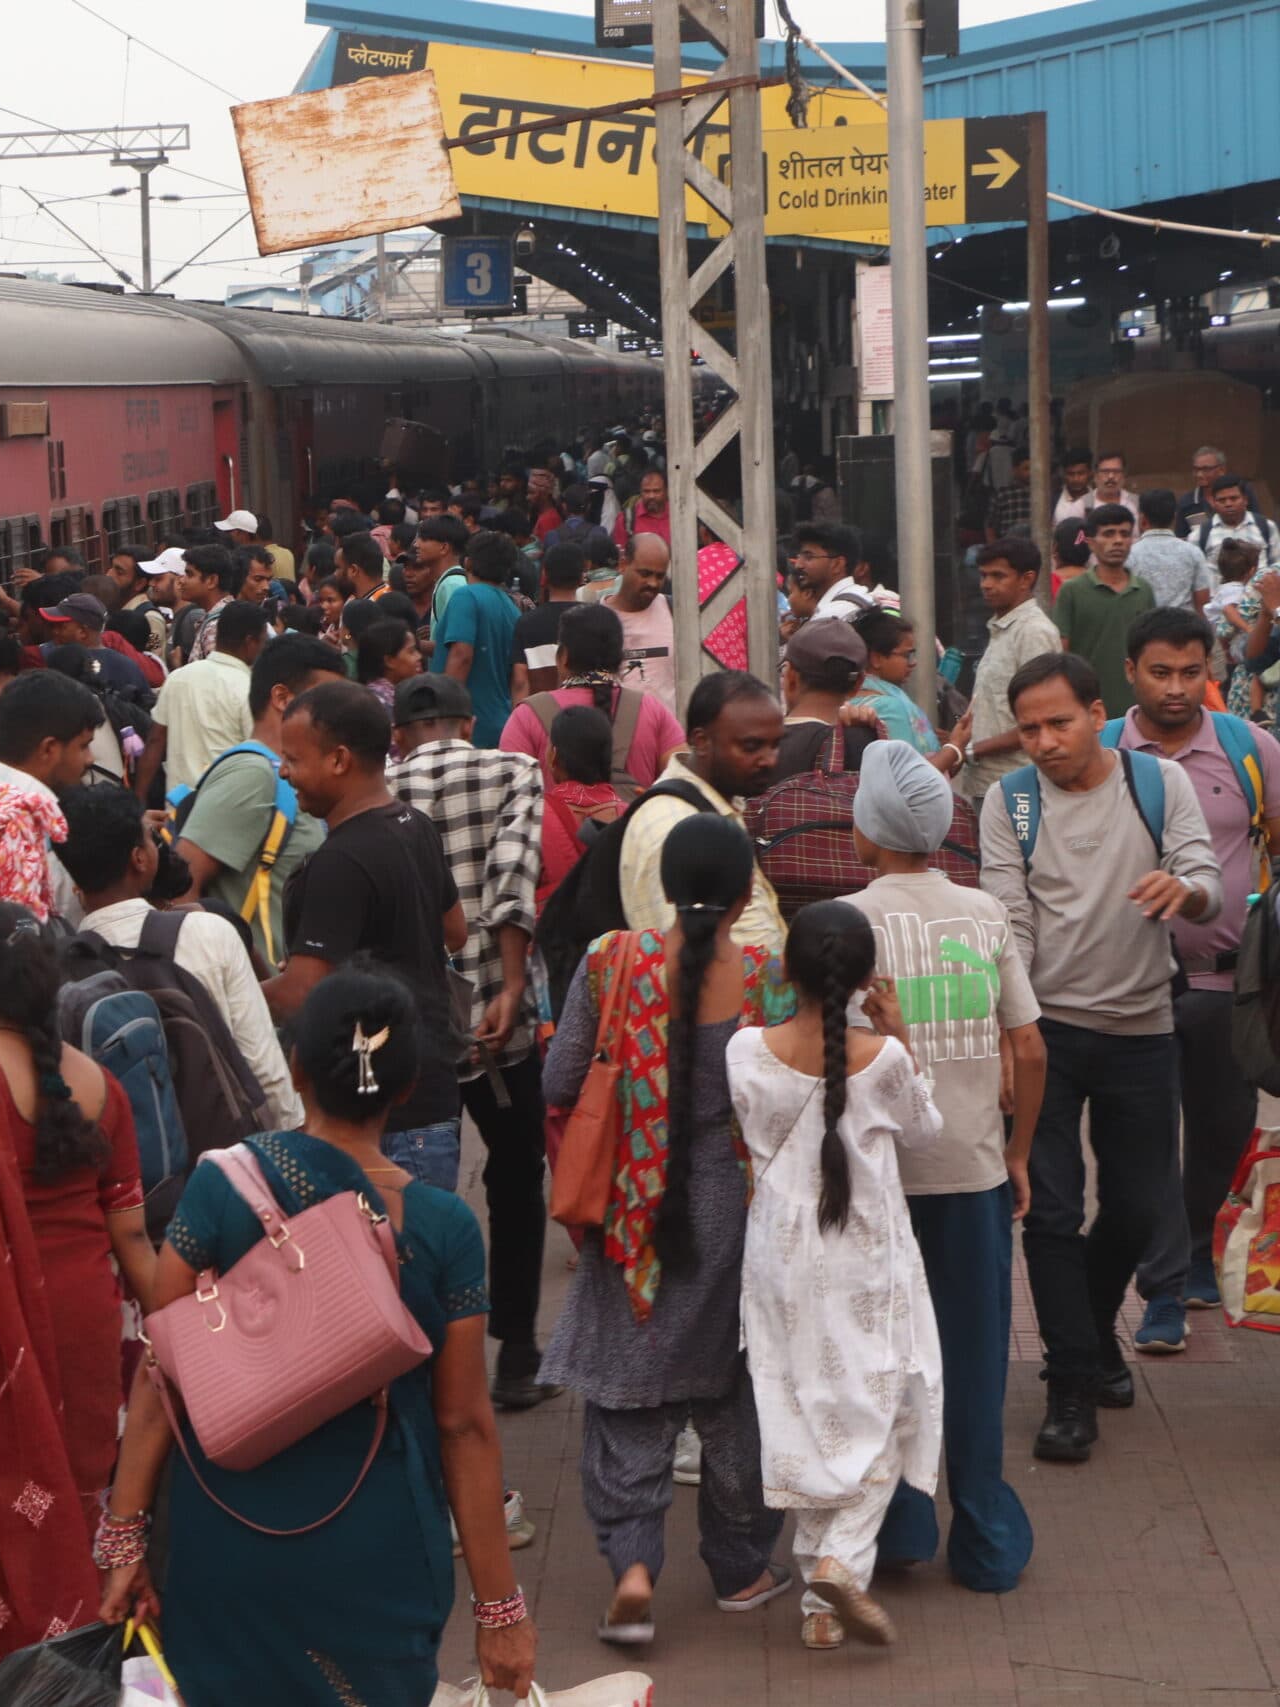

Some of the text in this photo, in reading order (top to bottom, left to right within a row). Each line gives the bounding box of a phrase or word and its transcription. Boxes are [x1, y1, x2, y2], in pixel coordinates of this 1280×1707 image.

[347, 43, 415, 70] प्लेटफार्म
[778, 151, 846, 180] शीतल
[778, 183, 957, 210] Cold Drinkin ater
[465, 251, 492, 297] 3
[1012, 792, 1031, 842] safari
